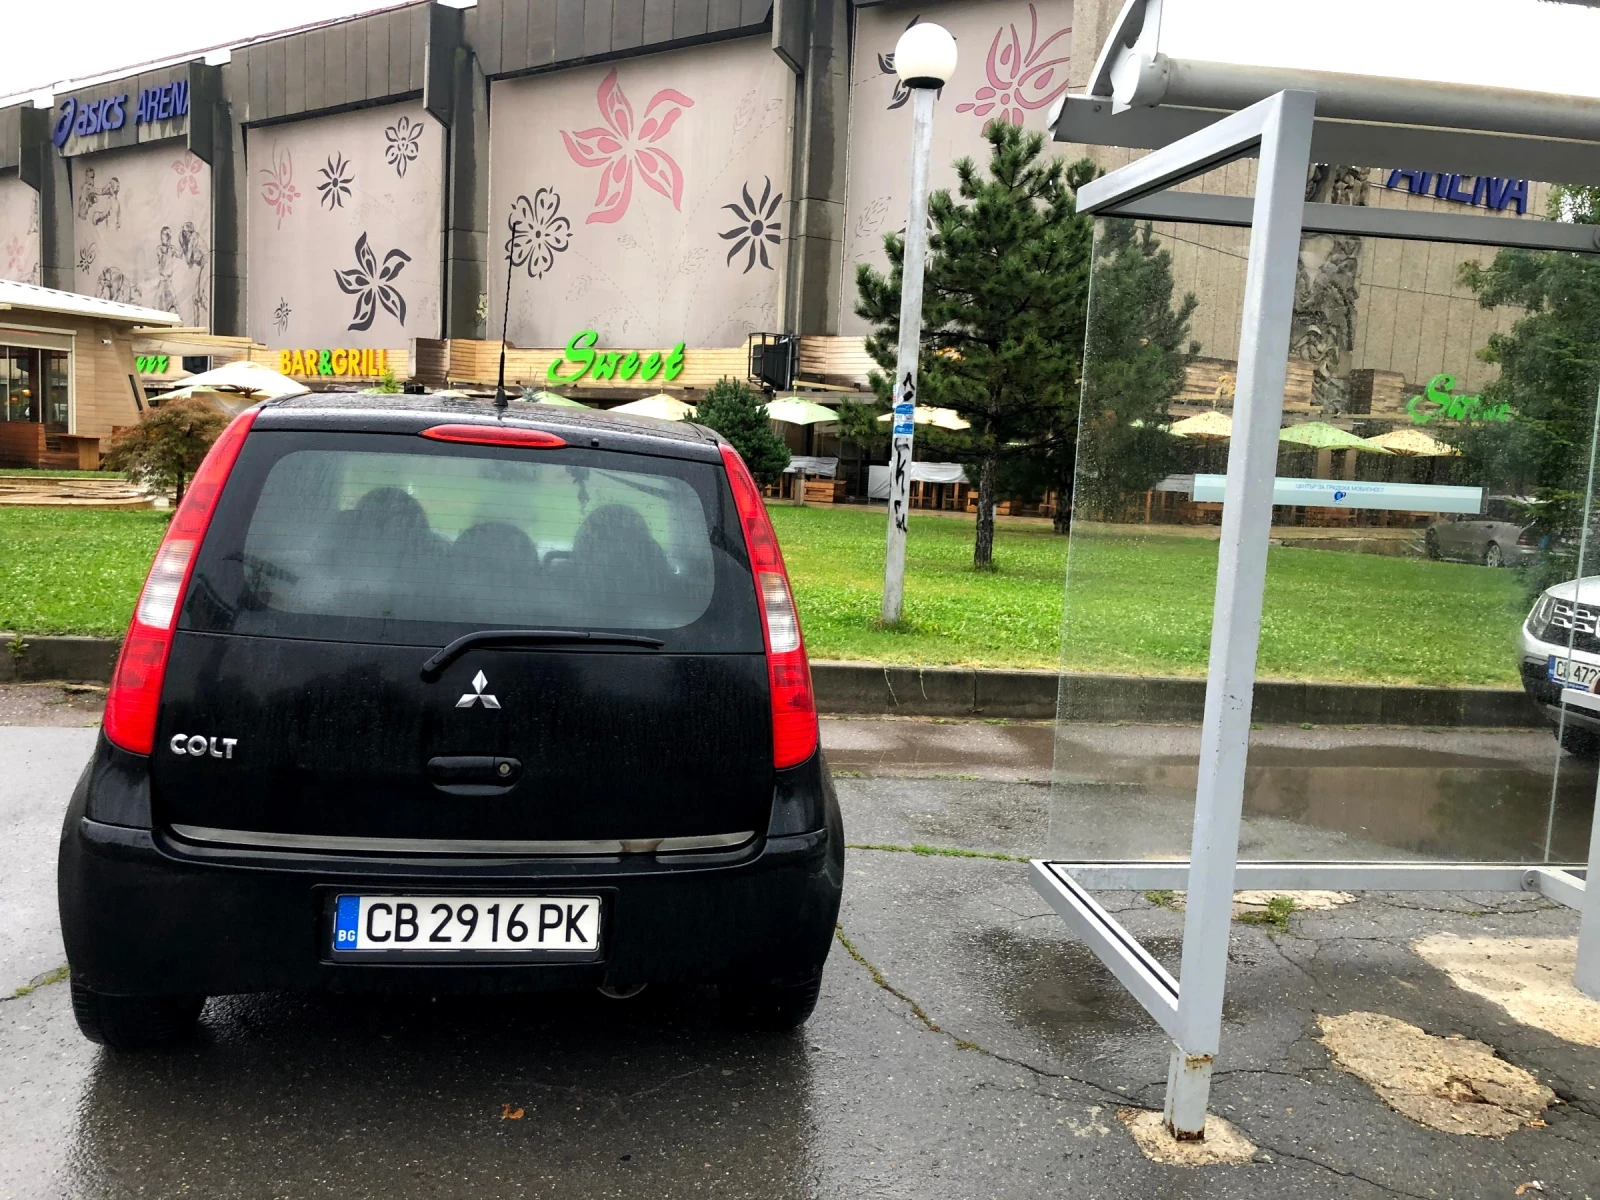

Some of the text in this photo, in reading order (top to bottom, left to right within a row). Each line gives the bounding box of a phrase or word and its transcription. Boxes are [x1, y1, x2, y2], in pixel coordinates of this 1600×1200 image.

[74, 95, 127, 137] asics
[280, 348, 388, 377] BAR&GRILL
[547, 329, 686, 386] Sweet
[1573, 665, 1600, 685] 472
[170, 733, 238, 759] COLT
[338, 929, 356, 942] BG
[366, 903, 589, 943] CB 2916 PK
